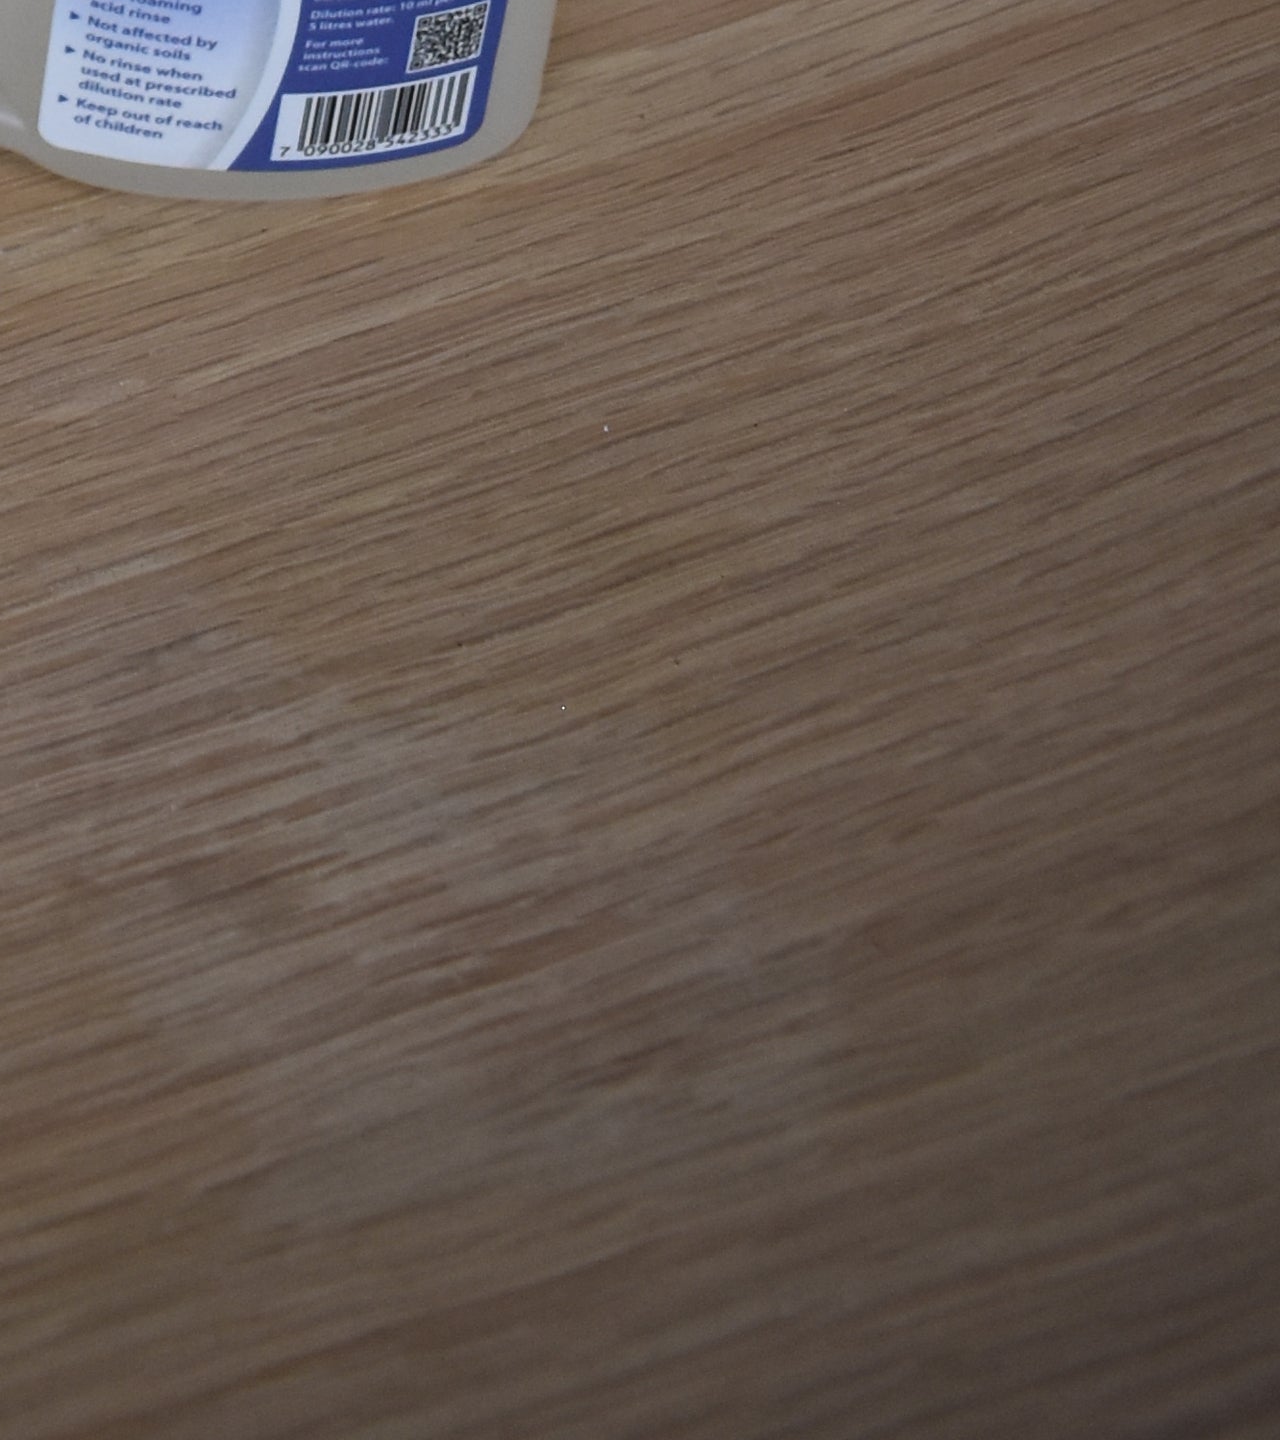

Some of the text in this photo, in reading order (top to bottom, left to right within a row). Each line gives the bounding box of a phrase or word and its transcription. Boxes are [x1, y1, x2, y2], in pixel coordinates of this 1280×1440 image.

[90, 0, 171, 24] acid rinse
[310, 9, 364, 20] Dilution
[366, 4, 396, 16] rate:
[400, 1, 415, 11] 10
[87, 16, 217, 51] Not affected by
[319, 20, 353, 31] litres
[86, 32, 192, 61] organic soils
[303, 47, 380, 61] instructions
[306, 38, 364, 49] For more
[82, 50, 203, 81] No rinse when
[298, 61, 327, 72] scan
[78, 80, 182, 108] dilution rate
[81, 66, 237, 99] used at prescribed
[73, 113, 163, 139] of children
[76, 98, 223, 131] Keep out of reach
[279, 146, 290, 157] 7
[303, 140, 375, 156] 090028
